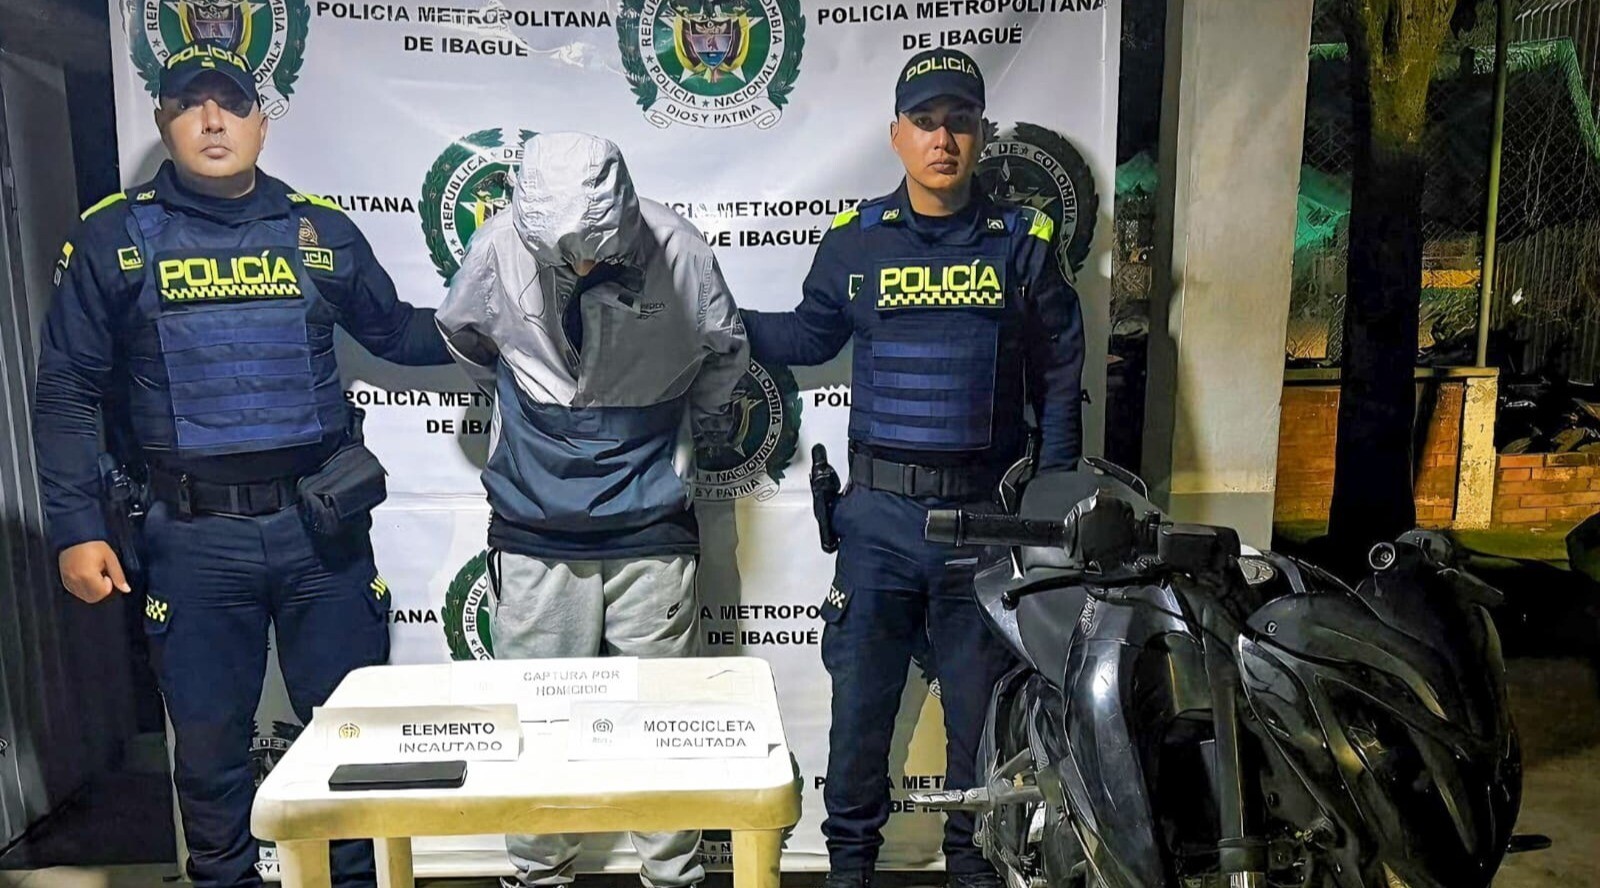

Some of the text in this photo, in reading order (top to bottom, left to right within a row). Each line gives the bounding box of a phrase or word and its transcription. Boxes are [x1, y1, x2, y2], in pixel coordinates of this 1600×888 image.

[418, 6, 612, 28] METROPOLITANA
[818, 0, 1105, 25] POLICIA METROPOLITANA
[404, 35, 434, 52] DE
[903, 23, 1023, 50] DE IBAGUÉ
[714, 61, 778, 108] NACIONAL
[714, 104, 762, 124] PATRIA
[717, 199, 862, 219] METROPOLIT
[739, 225, 821, 247] IBAGUÉ
[159, 251, 297, 288] POLICÍA
[880, 259, 1001, 294] POLICÍA
[426, 419, 454, 434] DE
[708, 628, 818, 645] DE IBAGUÉ
[523, 670, 620, 682] CAPTURA POR
[402, 722, 495, 736] ELEMENTO
[643, 720, 756, 732] MOTOCICLETA
[399, 741, 503, 754] INCAUTADO
[656, 737, 747, 749] INCAUTADA
